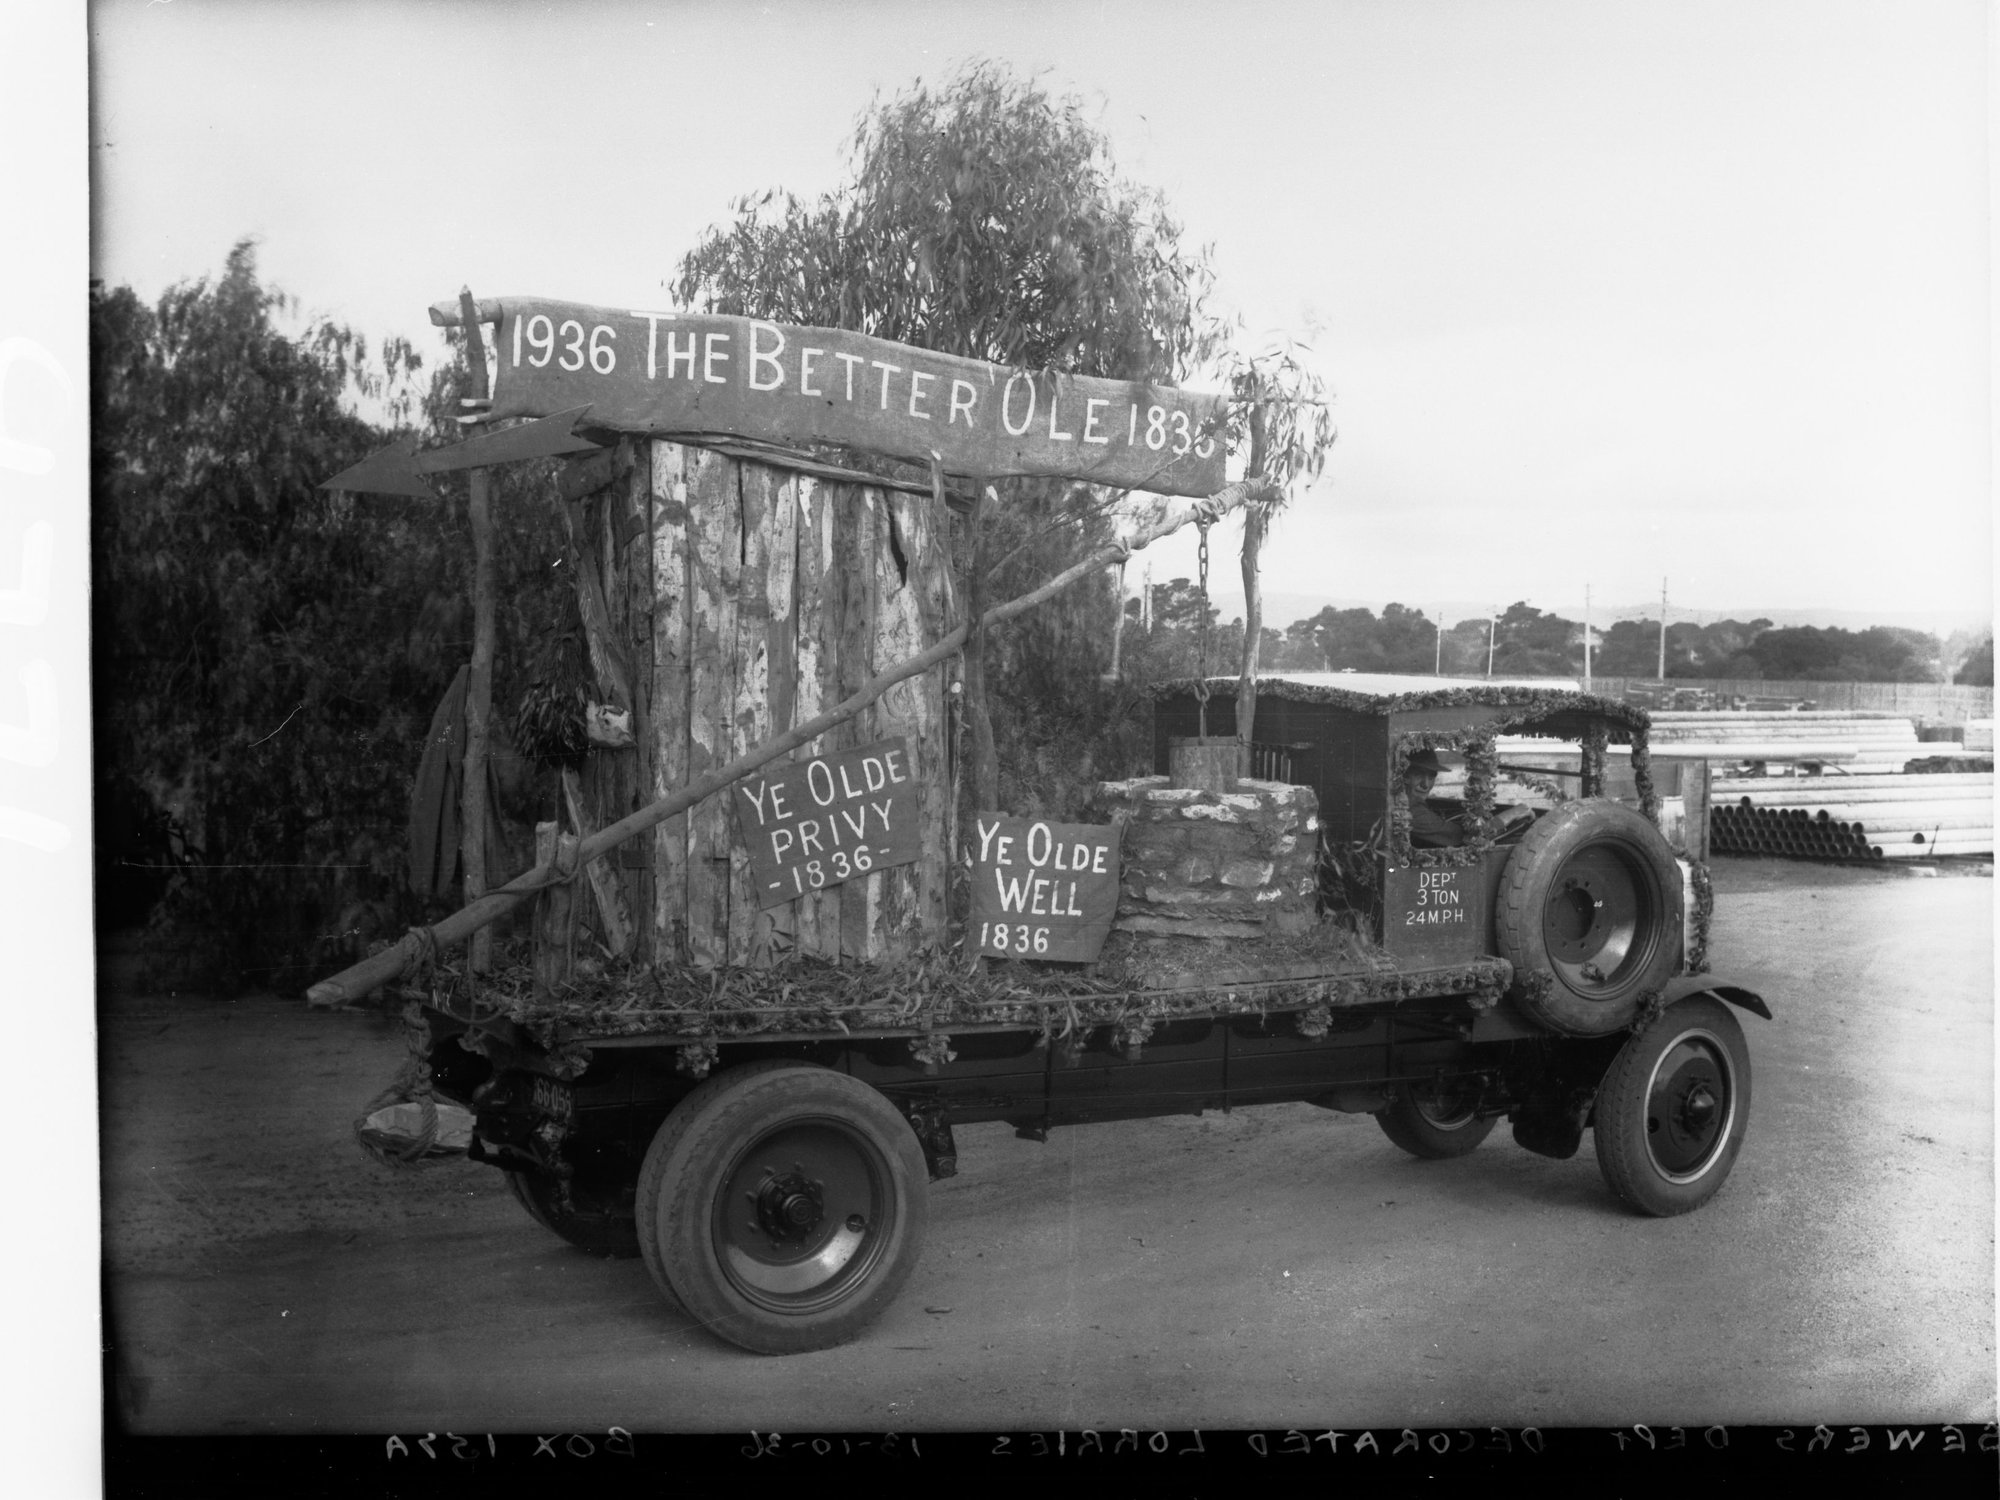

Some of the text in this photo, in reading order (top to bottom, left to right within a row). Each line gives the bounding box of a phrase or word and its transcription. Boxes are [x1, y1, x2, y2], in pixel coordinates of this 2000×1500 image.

[512, 314, 617, 375] 1936
[630, 310, 731, 383] THE
[749, 319, 977, 429] BETTER
[742, 749, 907, 825] YE OLDE
[770, 798, 893, 865] PRIVY
[976, 818, 1109, 874] YE OLDE
[995, 867, 1083, 917] WELL
[1417, 888, 1459, 906] 3 TON
[980, 921, 1050, 954] 1836
